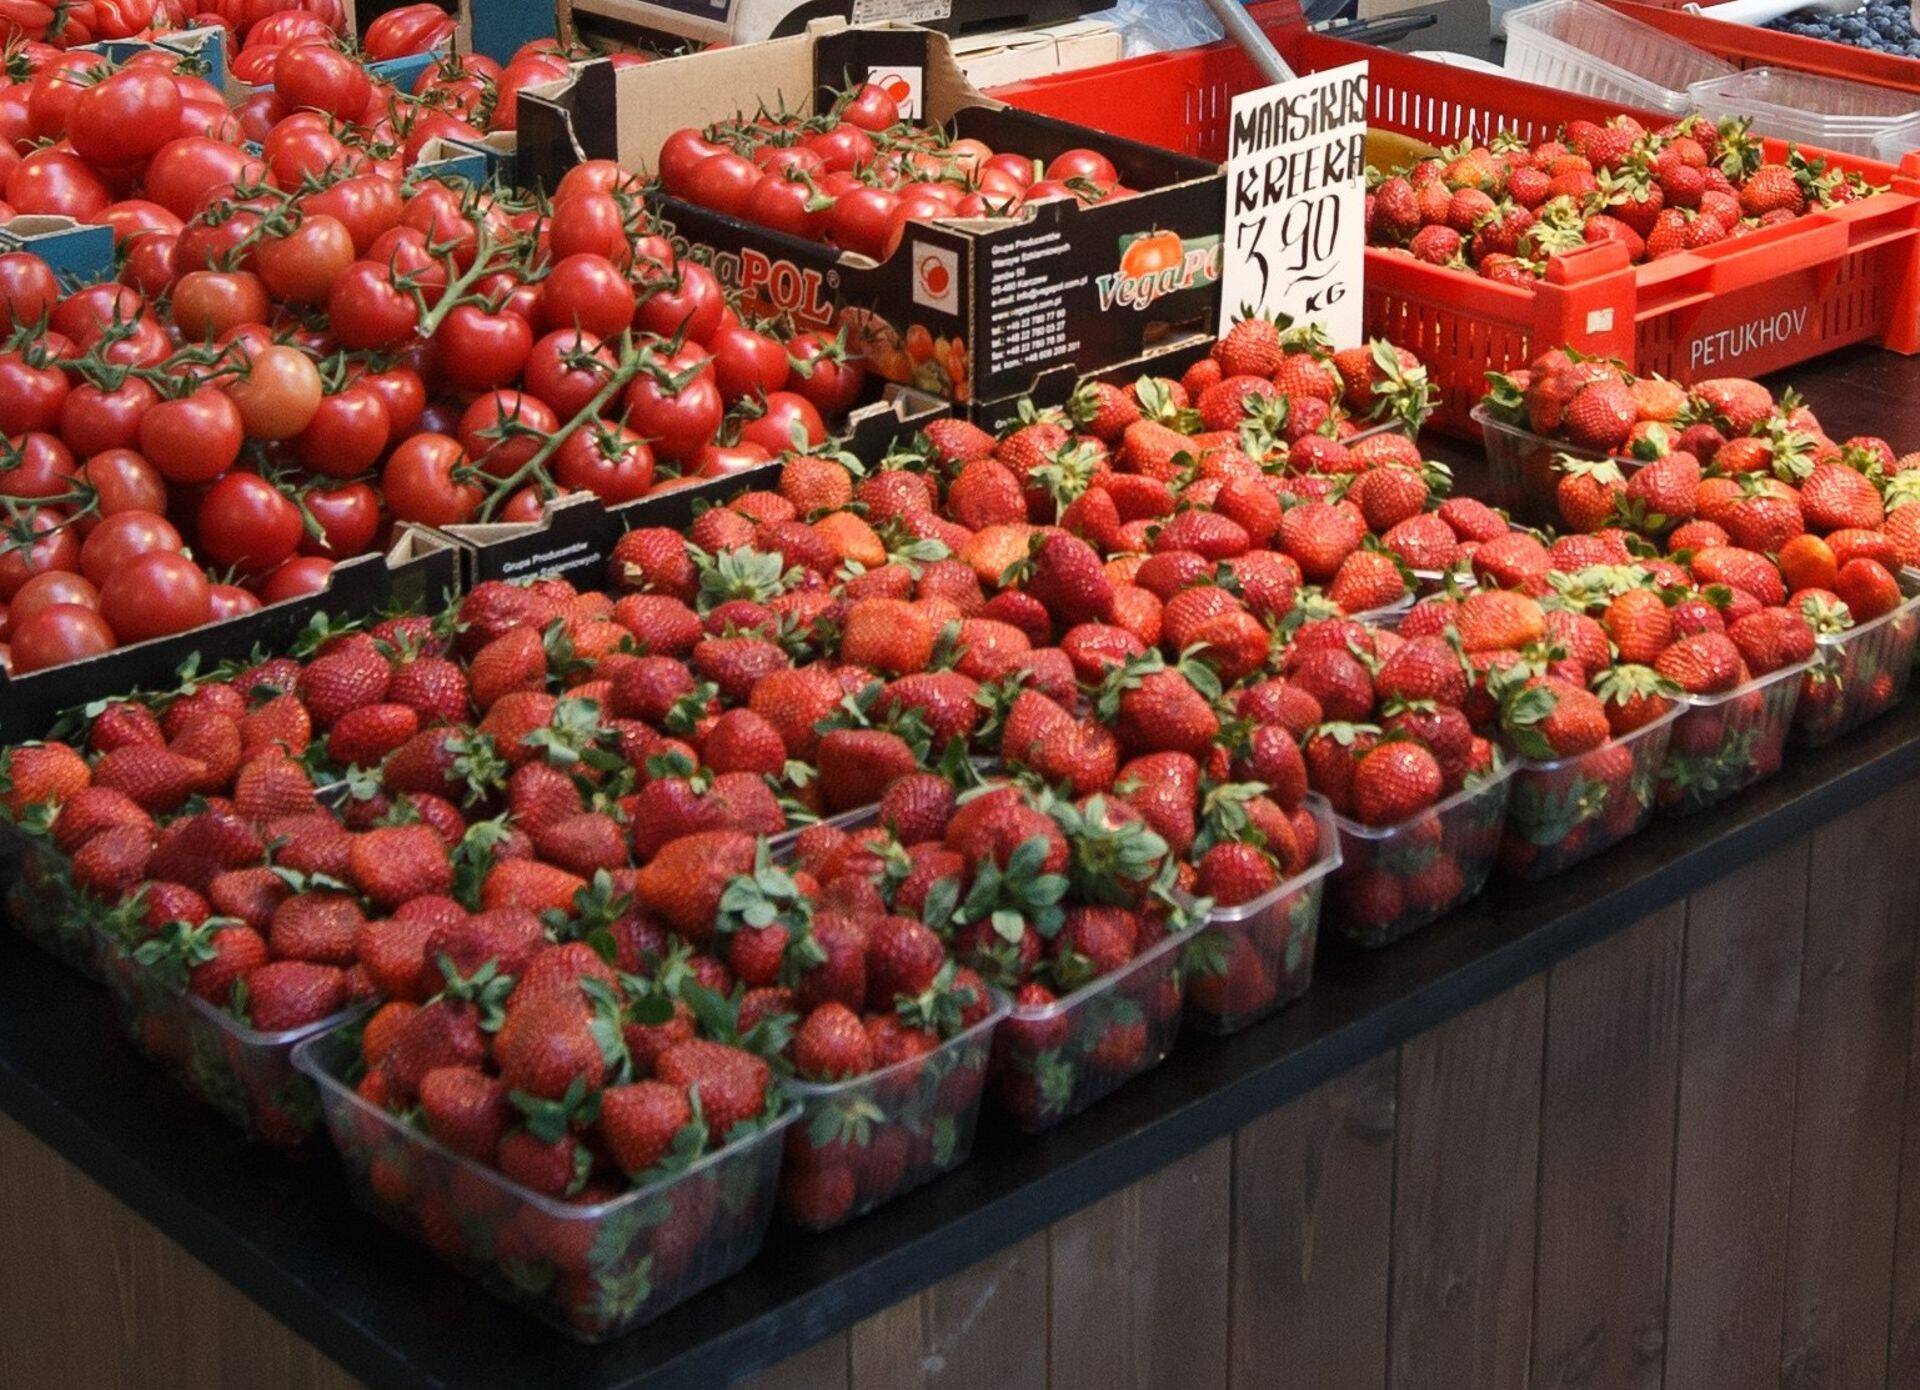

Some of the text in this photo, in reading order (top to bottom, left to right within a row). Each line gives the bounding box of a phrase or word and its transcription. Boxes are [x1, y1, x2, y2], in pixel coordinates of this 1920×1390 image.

[1234, 133, 1366, 217] KREEKA
[1305, 281, 1346, 313] KG
[1690, 307, 1807, 370] PETUKHOV
